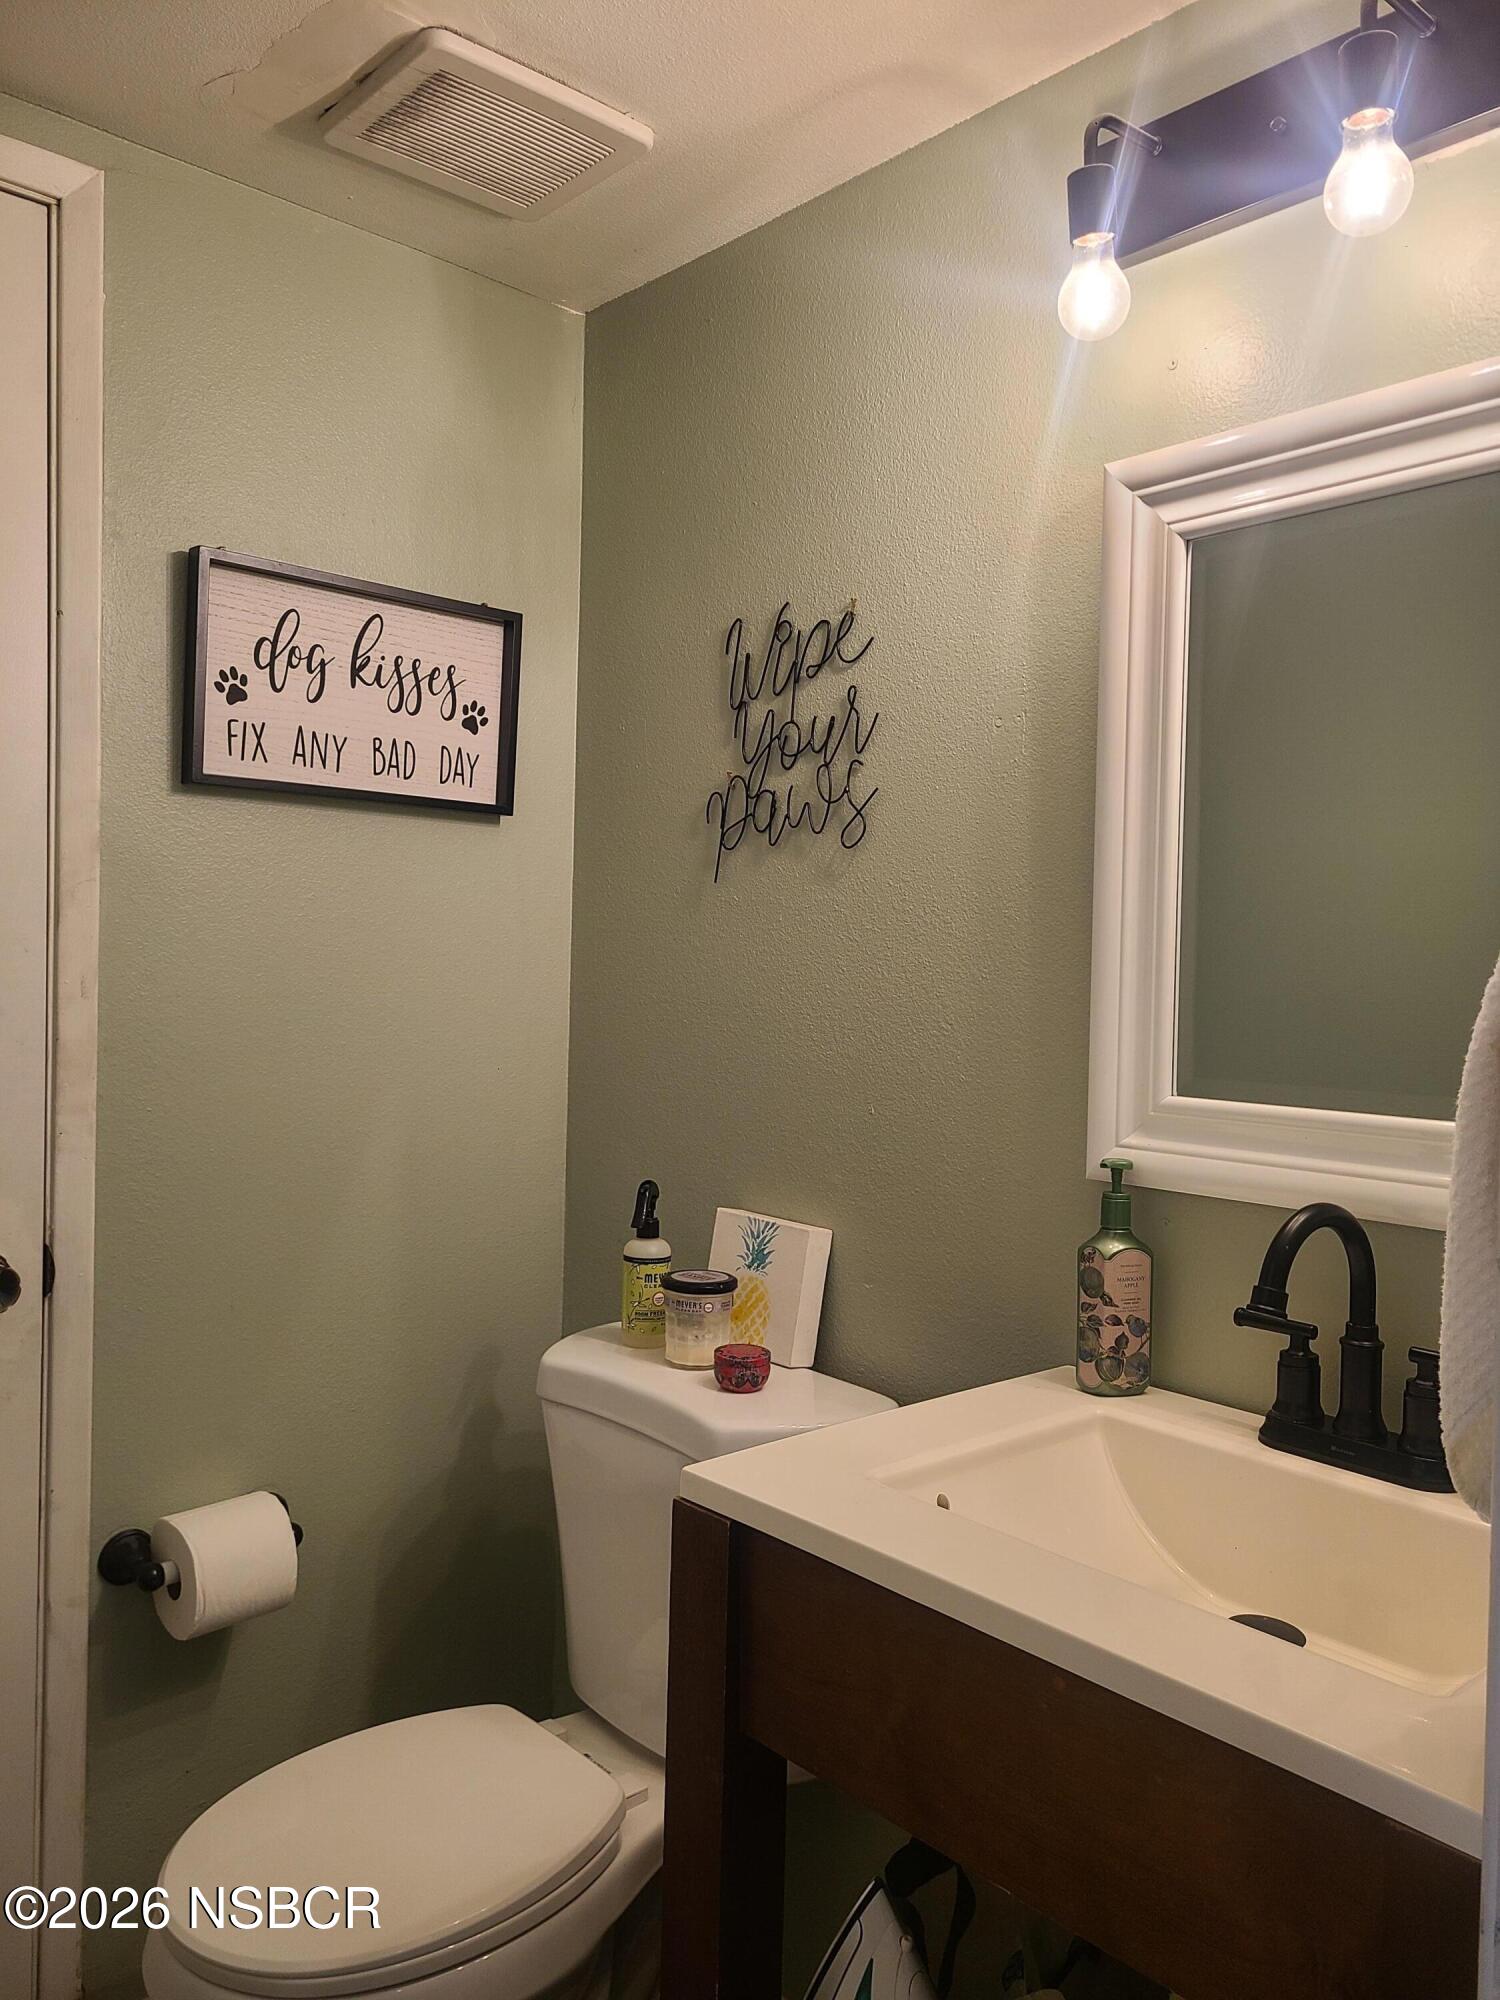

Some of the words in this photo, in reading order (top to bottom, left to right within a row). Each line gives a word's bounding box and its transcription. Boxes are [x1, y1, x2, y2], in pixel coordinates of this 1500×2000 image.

[253, 608, 336, 704] dog
[350, 613, 467, 722] kisses
[227, 718, 268, 764] FIX
[292, 724, 348, 774] ANY
[372, 736, 416, 781] BAD
[439, 744, 480, 789] DAY
